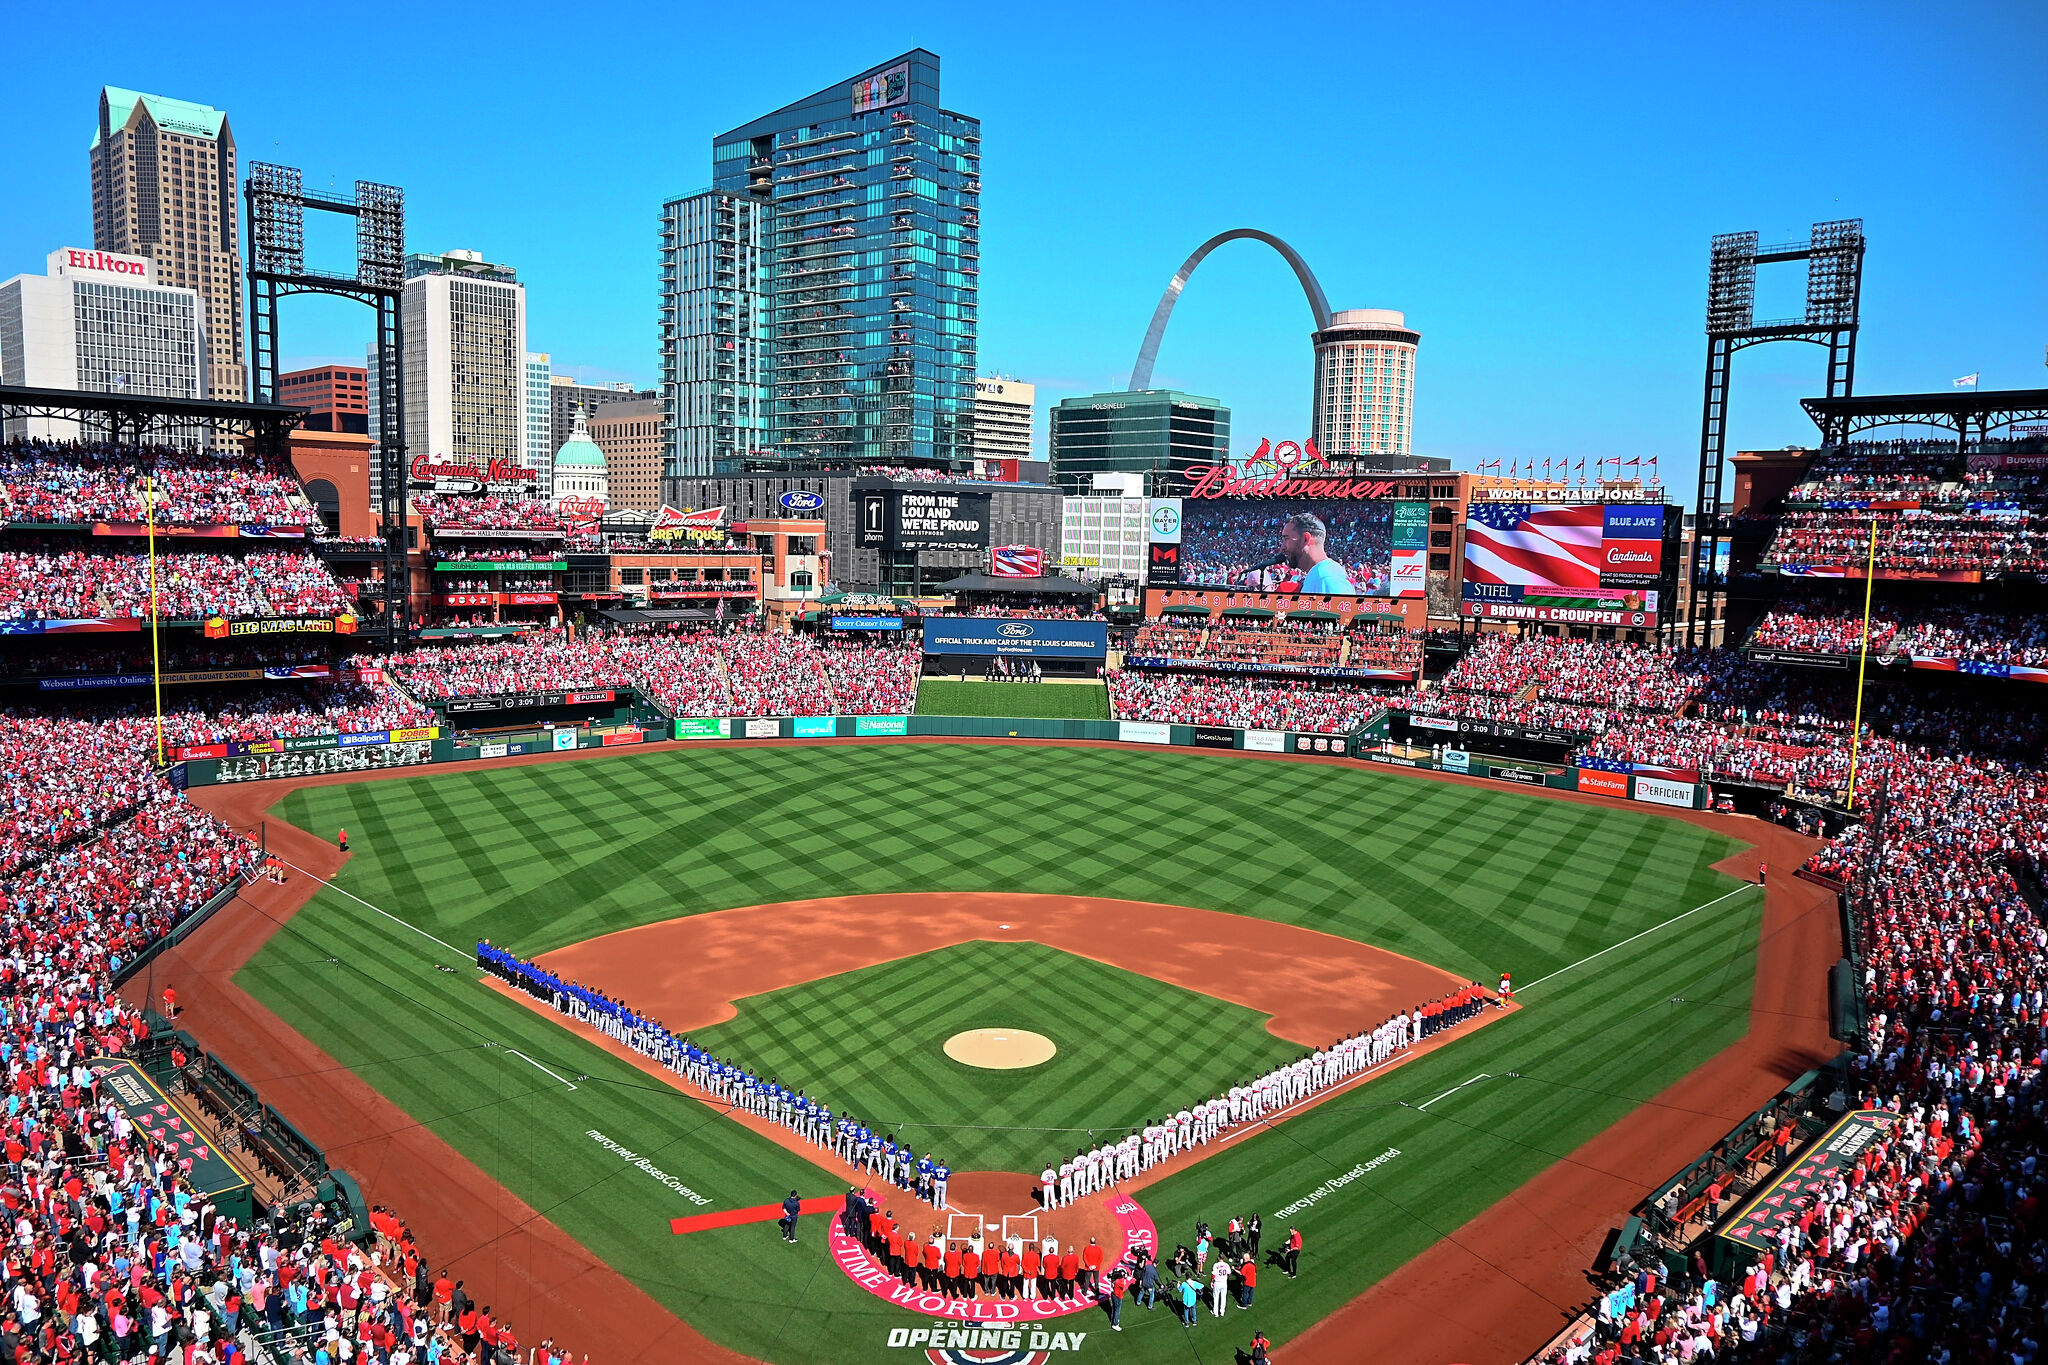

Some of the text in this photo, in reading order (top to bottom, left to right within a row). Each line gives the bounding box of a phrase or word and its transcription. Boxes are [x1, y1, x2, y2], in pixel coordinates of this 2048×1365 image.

[888, 71, 905, 82] PICK
[68, 250, 145, 276] Hilton
[1091, 402, 1126, 410] POLSINELLI
[411, 454, 538, 482] Cardinals Nation
[1184, 465, 1394, 499] Budweiser
[1488, 489, 1645, 500] WORLD CHAMPIONS
[559, 494, 606, 517] Bally
[789, 493, 816, 508] Ford
[902, 495, 959, 508] FROM THE
[902, 506, 951, 519] LOU AND
[651, 511, 724, 529] Budweiser
[901, 518, 980, 532] WE'RE PROUD
[1609, 517, 1656, 527] BLUE JAYS
[651, 529, 725, 541] BREW HOUSE
[864, 532, 884, 543] phorm
[1607, 547, 1653, 564] Cardinals
[450, 562, 479, 570] StubHub
[1910, 569, 1939, 579] Cardinals
[1474, 582, 1512, 598] STIFEL
[1188, 595, 1195, 605] 2
[1201, 596, 1207, 605] 6
[1213, 596, 1220, 606] 9
[1226, 596, 1236, 607] 10
[1243, 597, 1253, 608] 14
[1260, 598, 1270, 608] 17
[1276, 599, 1290, 609] 20
[1298, 600, 1311, 610] 23
[1317, 600, 1331, 611] 24
[1597, 598, 1624, 607] Cardinals
[1338, 601, 1351, 612] 42
[1358, 602, 1373, 612] 45
[1377, 603, 1391, 613] 85
[1473, 604, 1643, 624] BC BROWN & CROUPPEN BC
[231, 619, 333, 635] BIG MAC LAND
[1003, 624, 1028, 636] Ford
[935, 637, 962, 645] OFFICIAL
[1754, 653, 1772, 661] Mercy
[1172, 660, 1185, 668] OH,
[1187, 661, 1202, 669] SAY,
[1284, 666, 1313, 674] DAWN'S
[1341, 669, 1366, 677] LIGHT,
[41, 675, 147, 689] Webster University Online
[189, 671, 250, 682] GRADUATE SCHOOL
[518, 698, 534, 706] 3:09
[869, 720, 905, 729] National
[1424, 718, 1455, 726] Schnucks
[400, 729, 430, 738] DOBBS
[1473, 725, 1515, 736] 3:09 70°
[1525, 732, 1539, 740] Mercy
[295, 738, 338, 748] Central Bank
[352, 733, 385, 744] Ballpark
[1196, 733, 1233, 743] HeGetsUs.com
[248, 742, 270, 751] planet
[251, 746, 275, 754] fitness
[1390, 757, 1416, 767] STADIUM
[1500, 770, 1519, 781] Bally
[1590, 778, 1625, 790] State Farm
[1637, 782, 1691, 801] PERFICIENT
[1838, 1126, 1877, 1156] CHAMPIONS
[585, 1128, 713, 1206] mercy.net/BasesCovered
[1274, 1147, 1402, 1220] mercy.net/BasesCovered
[890, 1283, 1020, 1319] WORLD
[886, 1327, 1088, 1351] OPENING DAY
